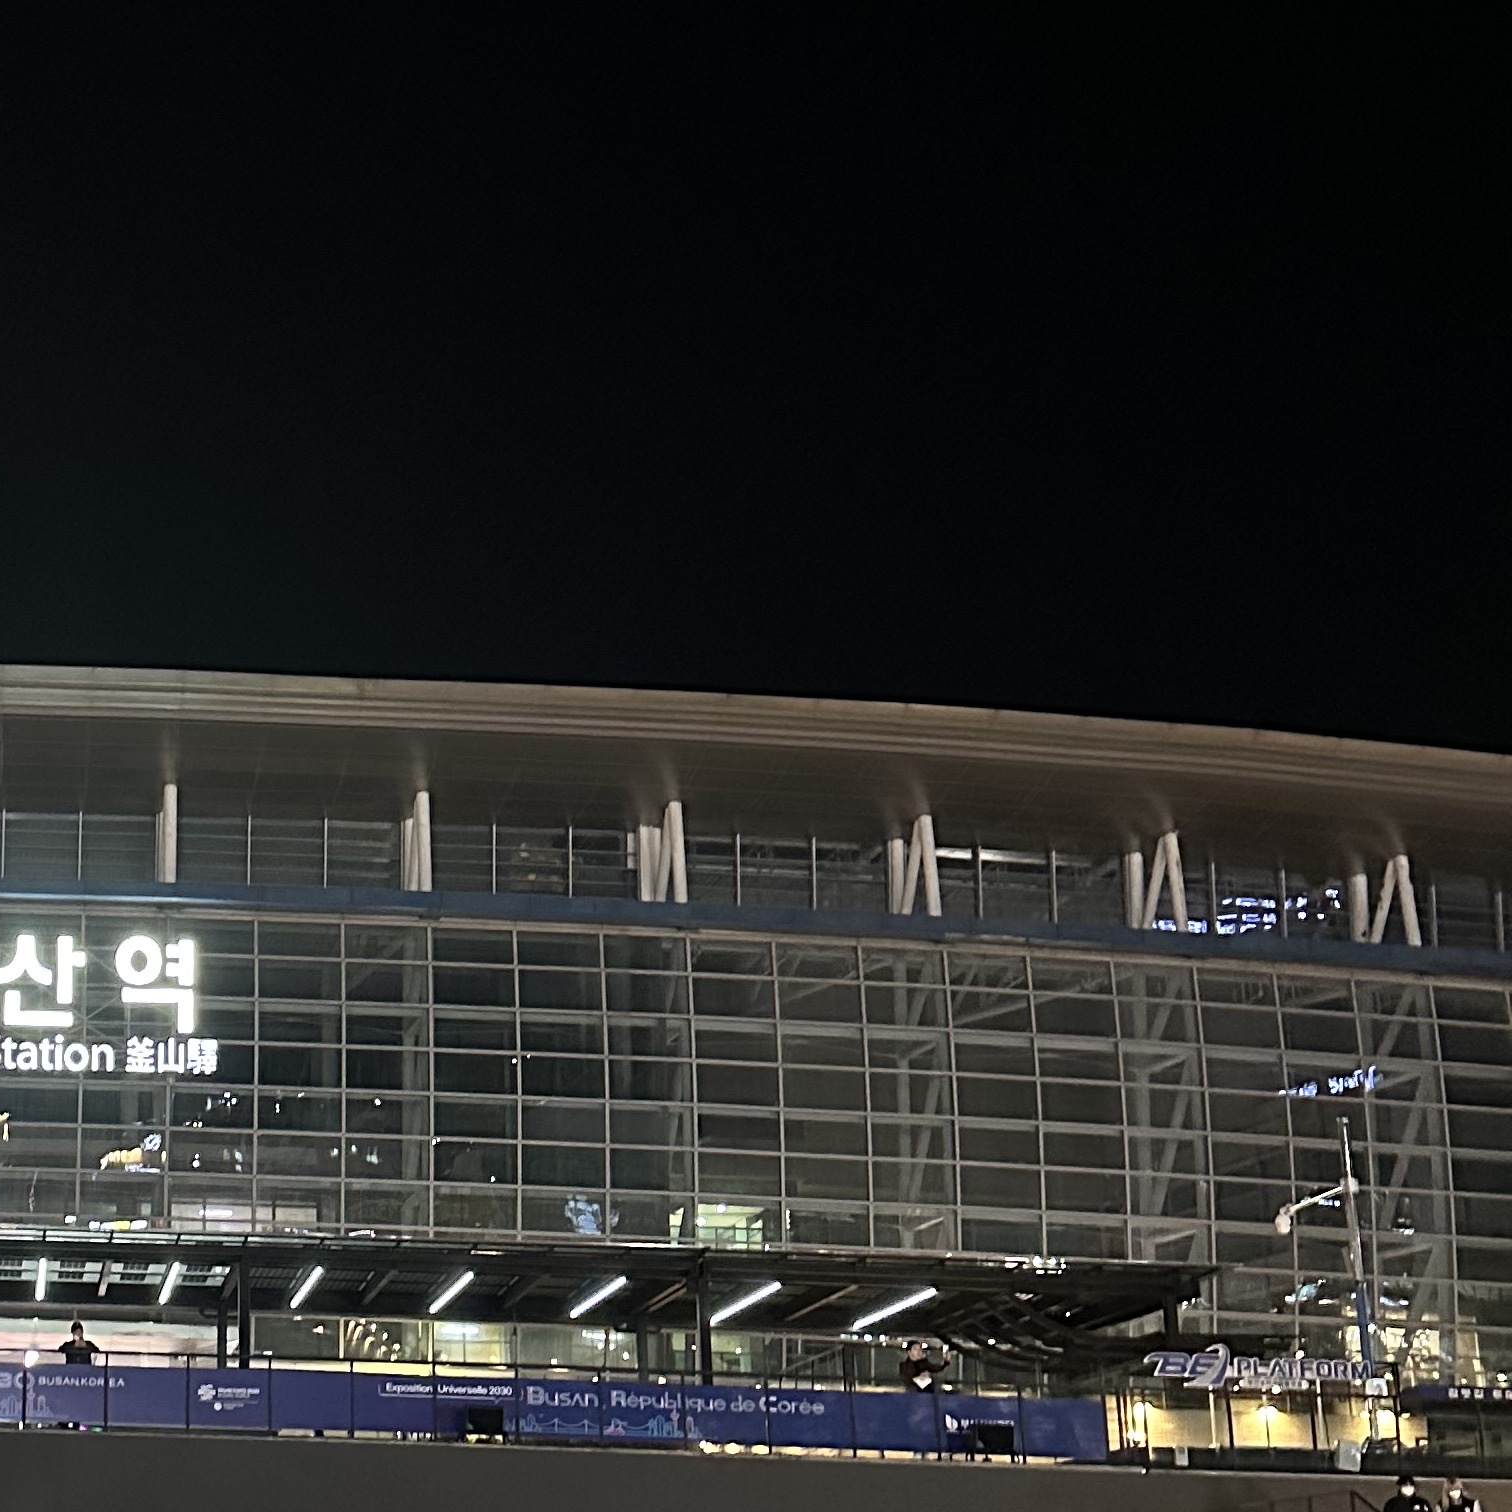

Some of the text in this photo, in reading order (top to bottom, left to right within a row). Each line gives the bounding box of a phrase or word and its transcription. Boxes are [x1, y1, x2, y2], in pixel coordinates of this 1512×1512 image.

[1233, 1356, 1373, 1381] PLATFORM
[385, 1382, 513, 1396] Exposition Universelle 2030
[610, 1389, 727, 1412] République
[730, 1394, 756, 1413] de
[759, 1395, 826, 1415] Corée
